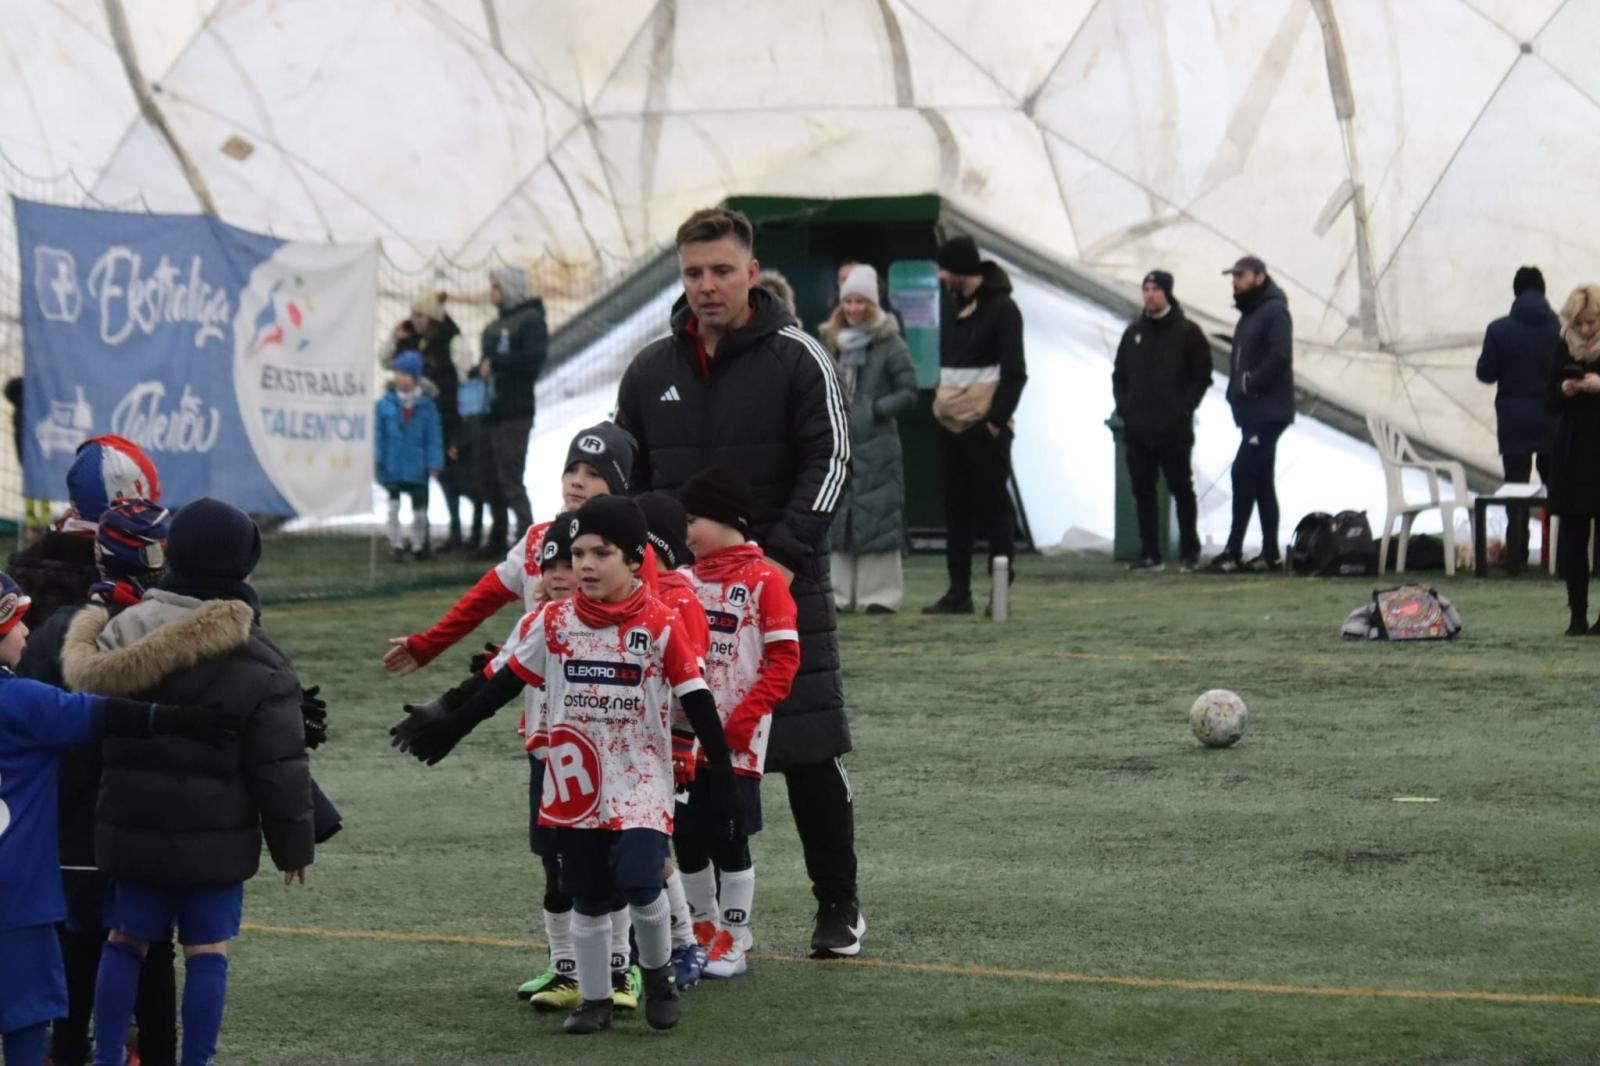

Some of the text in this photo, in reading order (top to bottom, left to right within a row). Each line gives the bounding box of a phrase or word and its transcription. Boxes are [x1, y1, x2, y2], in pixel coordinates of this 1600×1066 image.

[583, 438, 602, 452] JR
[729, 587, 746, 602] JR
[629, 631, 648, 651] JR
[564, 693, 640, 714] ostrog.net
